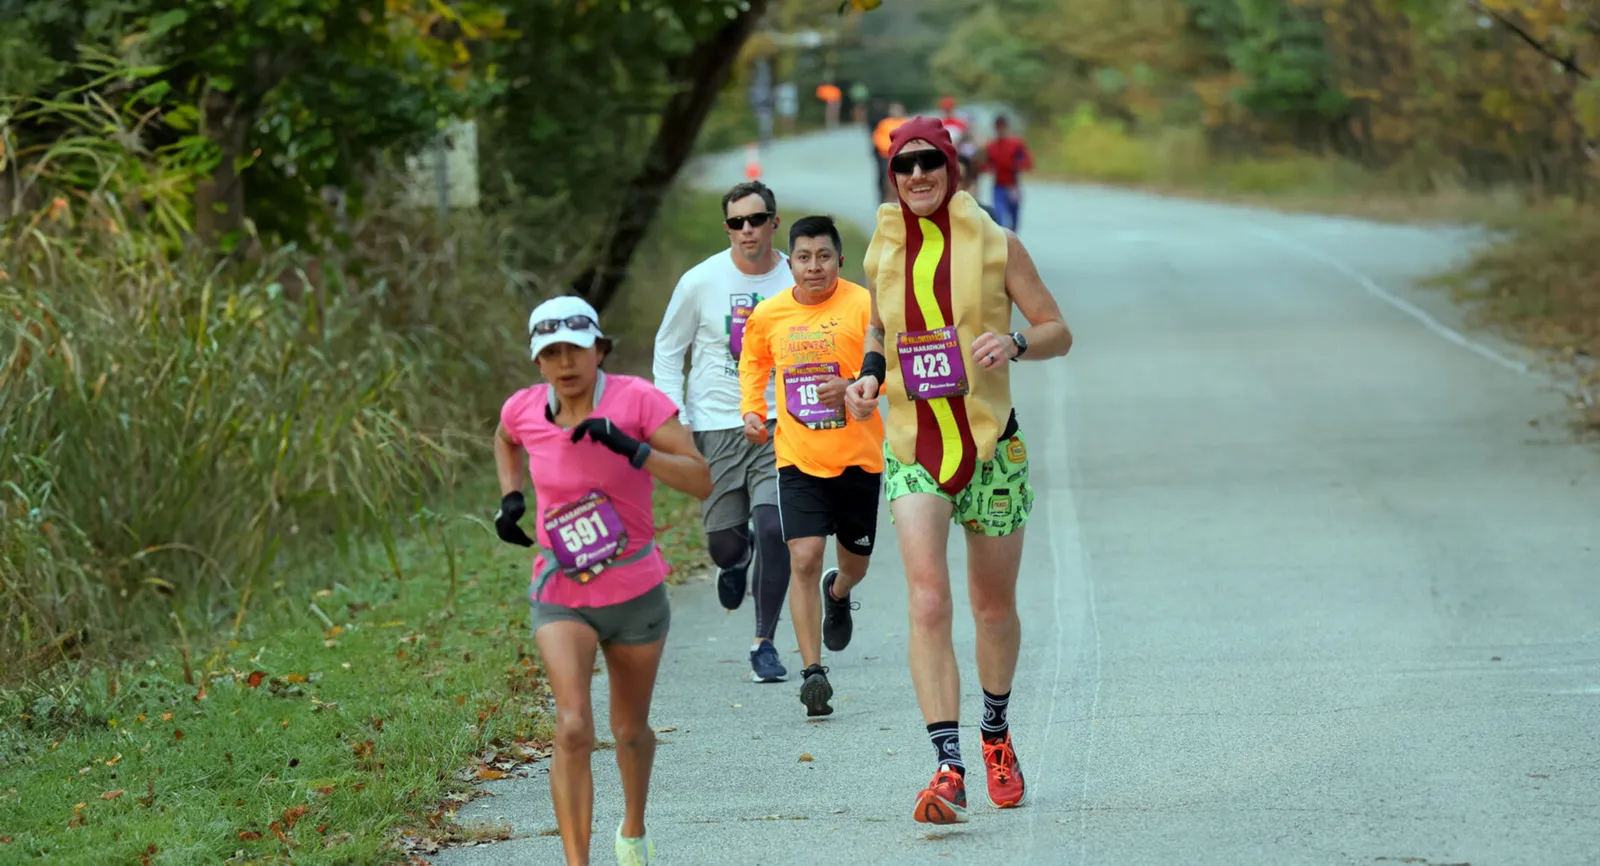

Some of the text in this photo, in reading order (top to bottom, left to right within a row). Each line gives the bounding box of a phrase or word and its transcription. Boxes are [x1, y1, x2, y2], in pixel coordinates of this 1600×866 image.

[899, 346, 912, 354] HALF
[913, 343, 945, 353] MARATHON
[913, 352, 951, 378] 423
[558, 510, 609, 553] 591
